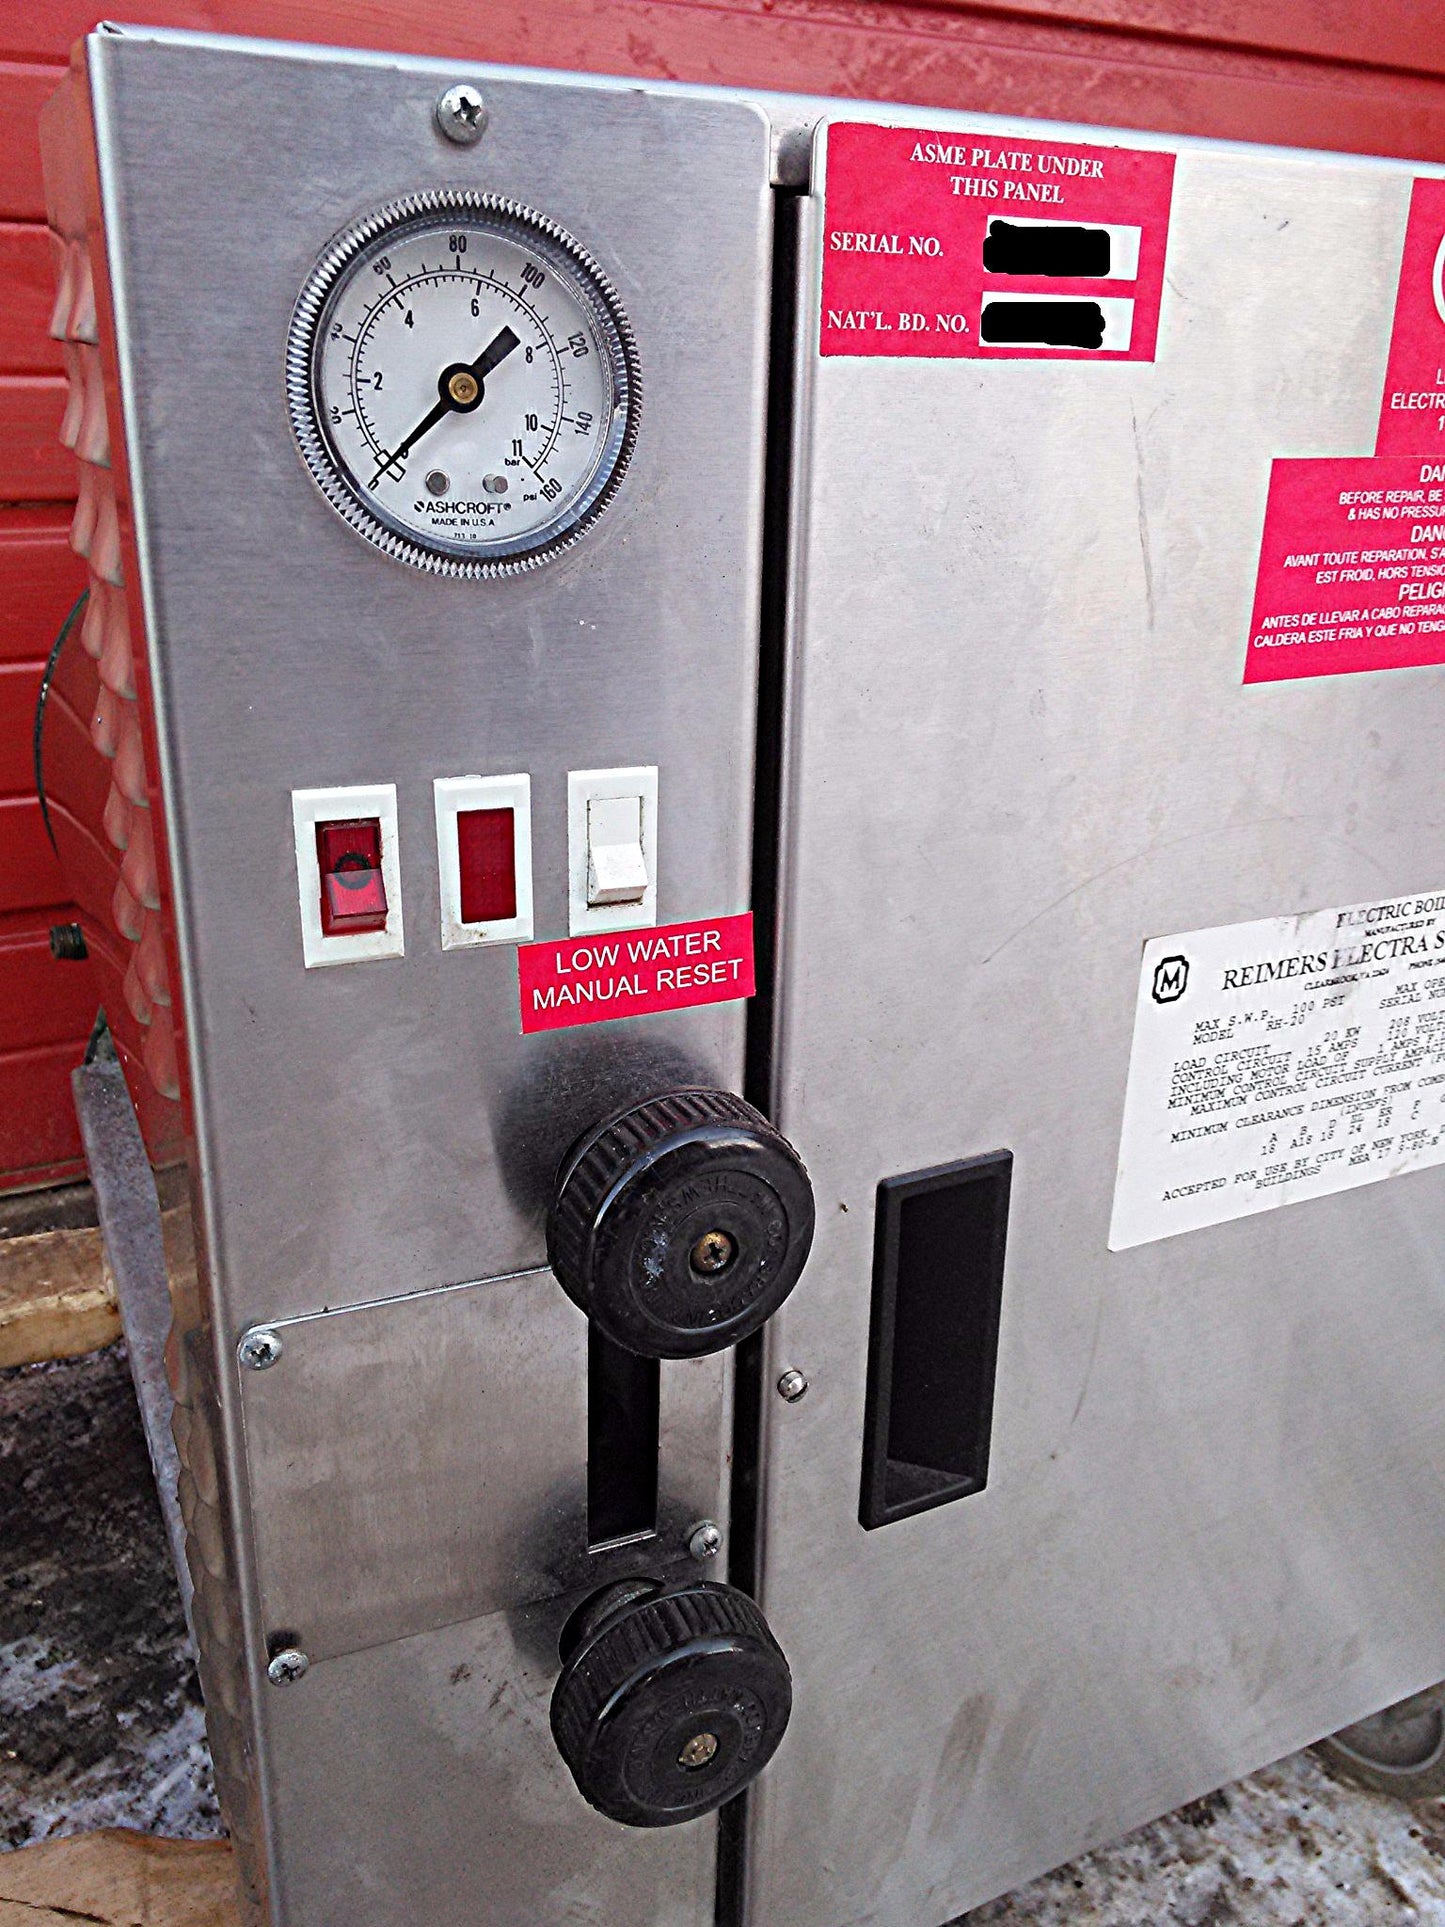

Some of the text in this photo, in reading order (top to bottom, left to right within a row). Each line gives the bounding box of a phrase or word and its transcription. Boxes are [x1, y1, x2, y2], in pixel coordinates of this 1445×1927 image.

[910, 143, 1105, 179] ASME PLATE UNDER
[950, 176, 1065, 204] THIS PANEL
[448, 234, 467, 253] 80
[830, 231, 944, 257] SERIAL NO.
[372, 256, 392, 276] 60
[520, 262, 546, 290] 100
[404, 310, 414, 329] 4
[470, 298, 480, 317] 6
[827, 310, 970, 333] NAT'L. BD. NO.
[525, 346, 534, 364] 8
[568, 331, 590, 358] 120
[373, 371, 384, 391] 2
[525, 413, 538, 432] 10
[574, 411, 594, 437] 140
[511, 439, 523, 457] 11
[504, 457, 521, 467] bar
[523, 477, 564, 502] psi 160
[1339, 491, 1384, 505] BEFORE
[1428, 489, 1443, 502] BE
[432, 518, 458, 526] MADE
[461, 518, 471, 526] IN
[1347, 507, 1356, 520] &
[1358, 507, 1381, 520] HAS
[1383, 507, 1399, 520] NO
[1284, 553, 1320, 568] AVANT
[1323, 551, 1358, 566] TOUTE
[1316, 570, 1338, 584] EST
[1378, 566, 1408, 580] HORS
[1262, 615, 1299, 630] ANTES
[1301, 613, 1317, 627] DE
[1319, 609, 1360, 625] LLEVAR
[1360, 609, 1369, 622] A
[1371, 606, 1401, 621] CABO
[1254, 634, 1308, 648] CALDERA
[1308, 631, 1338, 645] ESTE
[1338, 626, 1364, 641] FRIA
[1365, 625, 1373, 638] Y
[1374, 624, 1397, 638] QUE
[1399, 622, 1416, 635] NO
[556, 930, 721, 974] LOW WATER
[1221, 951, 1328, 991] REIMERS
[532, 958, 744, 1011] MANUAL RESET
[1193, 1028, 1234, 1045] MODEL
[1379, 992, 1421, 1010] SERIAL
[1195, 1018, 1220, 1032] MAX
[1293, 1000, 1315, 1014] 100
[1322, 994, 1345, 1009] PSI
[1396, 982, 1418, 995] MAX
[1171, 1064, 1229, 1085] CONTROL
[1237, 1051, 1292, 1071] CIRCUIT
[1307, 1044, 1322, 1057] 15
[1328, 1038, 1359, 1053] AMPS
[1173, 1057, 1207, 1073] LOAD
[1214, 1044, 1271, 1064] CIRCUIT
[1324, 1030, 1338, 1042] 20
[1170, 1073, 1243, 1097] INCLUDING
[1251, 1064, 1290, 1081] MOTOR
[1297, 1055, 1327, 1071] LOAD
[1333, 1050, 1350, 1063] OF
[1391, 1036, 1420, 1051] AMPS
[1168, 1088, 1226, 1109] MINIMUM
[1233, 1075, 1288, 1095] CONTROL
[1296, 1062, 1347, 1082] CIRCUIT
[1354, 1052, 1398, 1070] SUPPLY
[1190, 1095, 1248, 1116] MAXIMUM
[1255, 1082, 1307, 1102] CONTROL
[1315, 1069, 1367, 1088] CIRCUIT
[1373, 1057, 1423, 1076] CURRENT
[1170, 1121, 1228, 1143] MINIMUM
[1236, 1104, 1305, 1128] CLEARANCE
[1310, 1088, 1377, 1112] DIMENSION
[1384, 1081, 1412, 1095] FROM
[1162, 1177, 1227, 1202] ACCEPTED
[1233, 1170, 1258, 1185] FOR
[1265, 1162, 1288, 1176] USE
[1294, 1156, 1310, 1168] BY
[1316, 1148, 1346, 1164] CITY
[1351, 1143, 1366, 1154] OF
[1371, 1136, 1394, 1151] NEW
[1255, 1164, 1322, 1190] BUILDINGS
